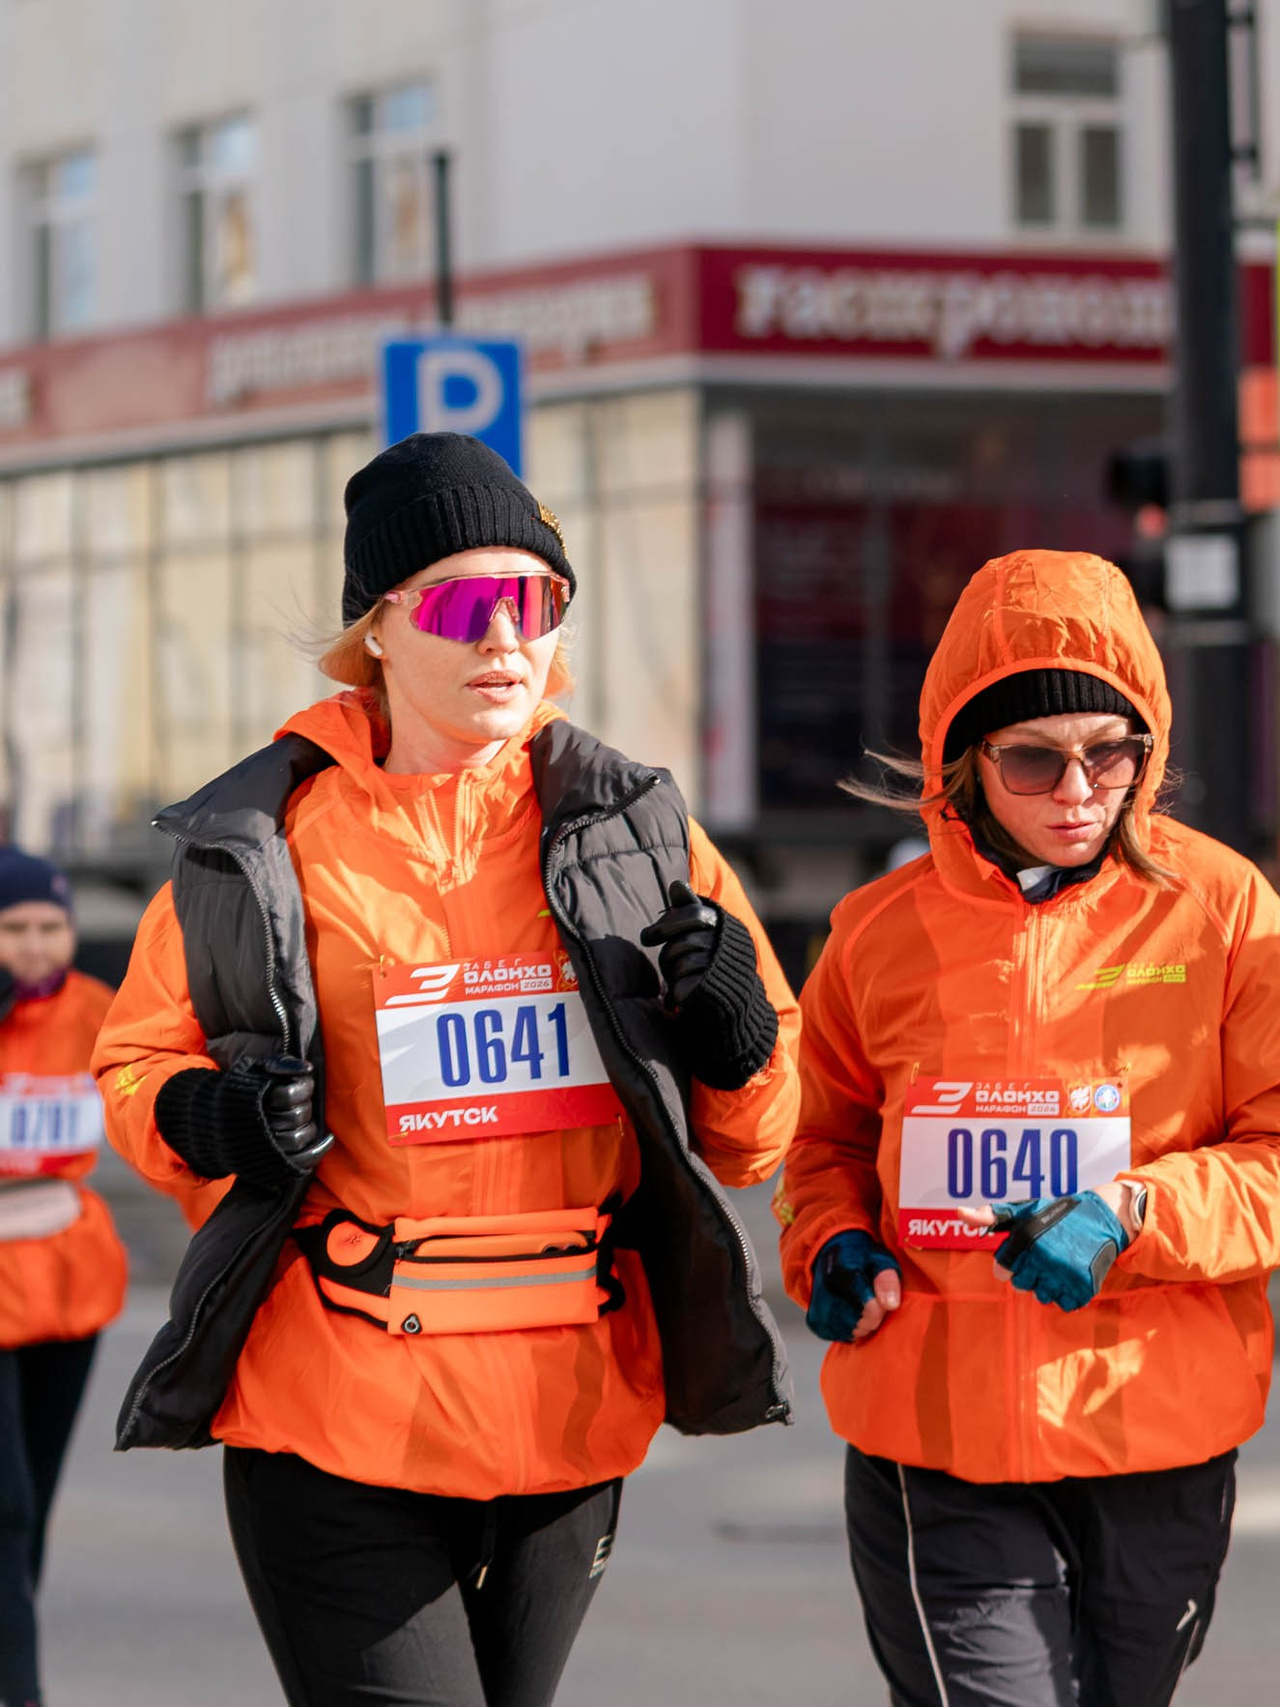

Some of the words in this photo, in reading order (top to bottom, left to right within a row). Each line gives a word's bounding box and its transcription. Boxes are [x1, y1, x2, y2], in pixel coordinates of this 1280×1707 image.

[464, 964, 552, 984] ОЛОНХО
[465, 983, 519, 995] МАРАФОН
[436, 1003, 570, 1087] 0641
[975, 1090, 1060, 1103] ОЛОНХО
[975, 1104, 1026, 1113] МАРАФОН
[399, 1106, 499, 1132] ЯКУТСК
[947, 1128, 1078, 1200] 0640
